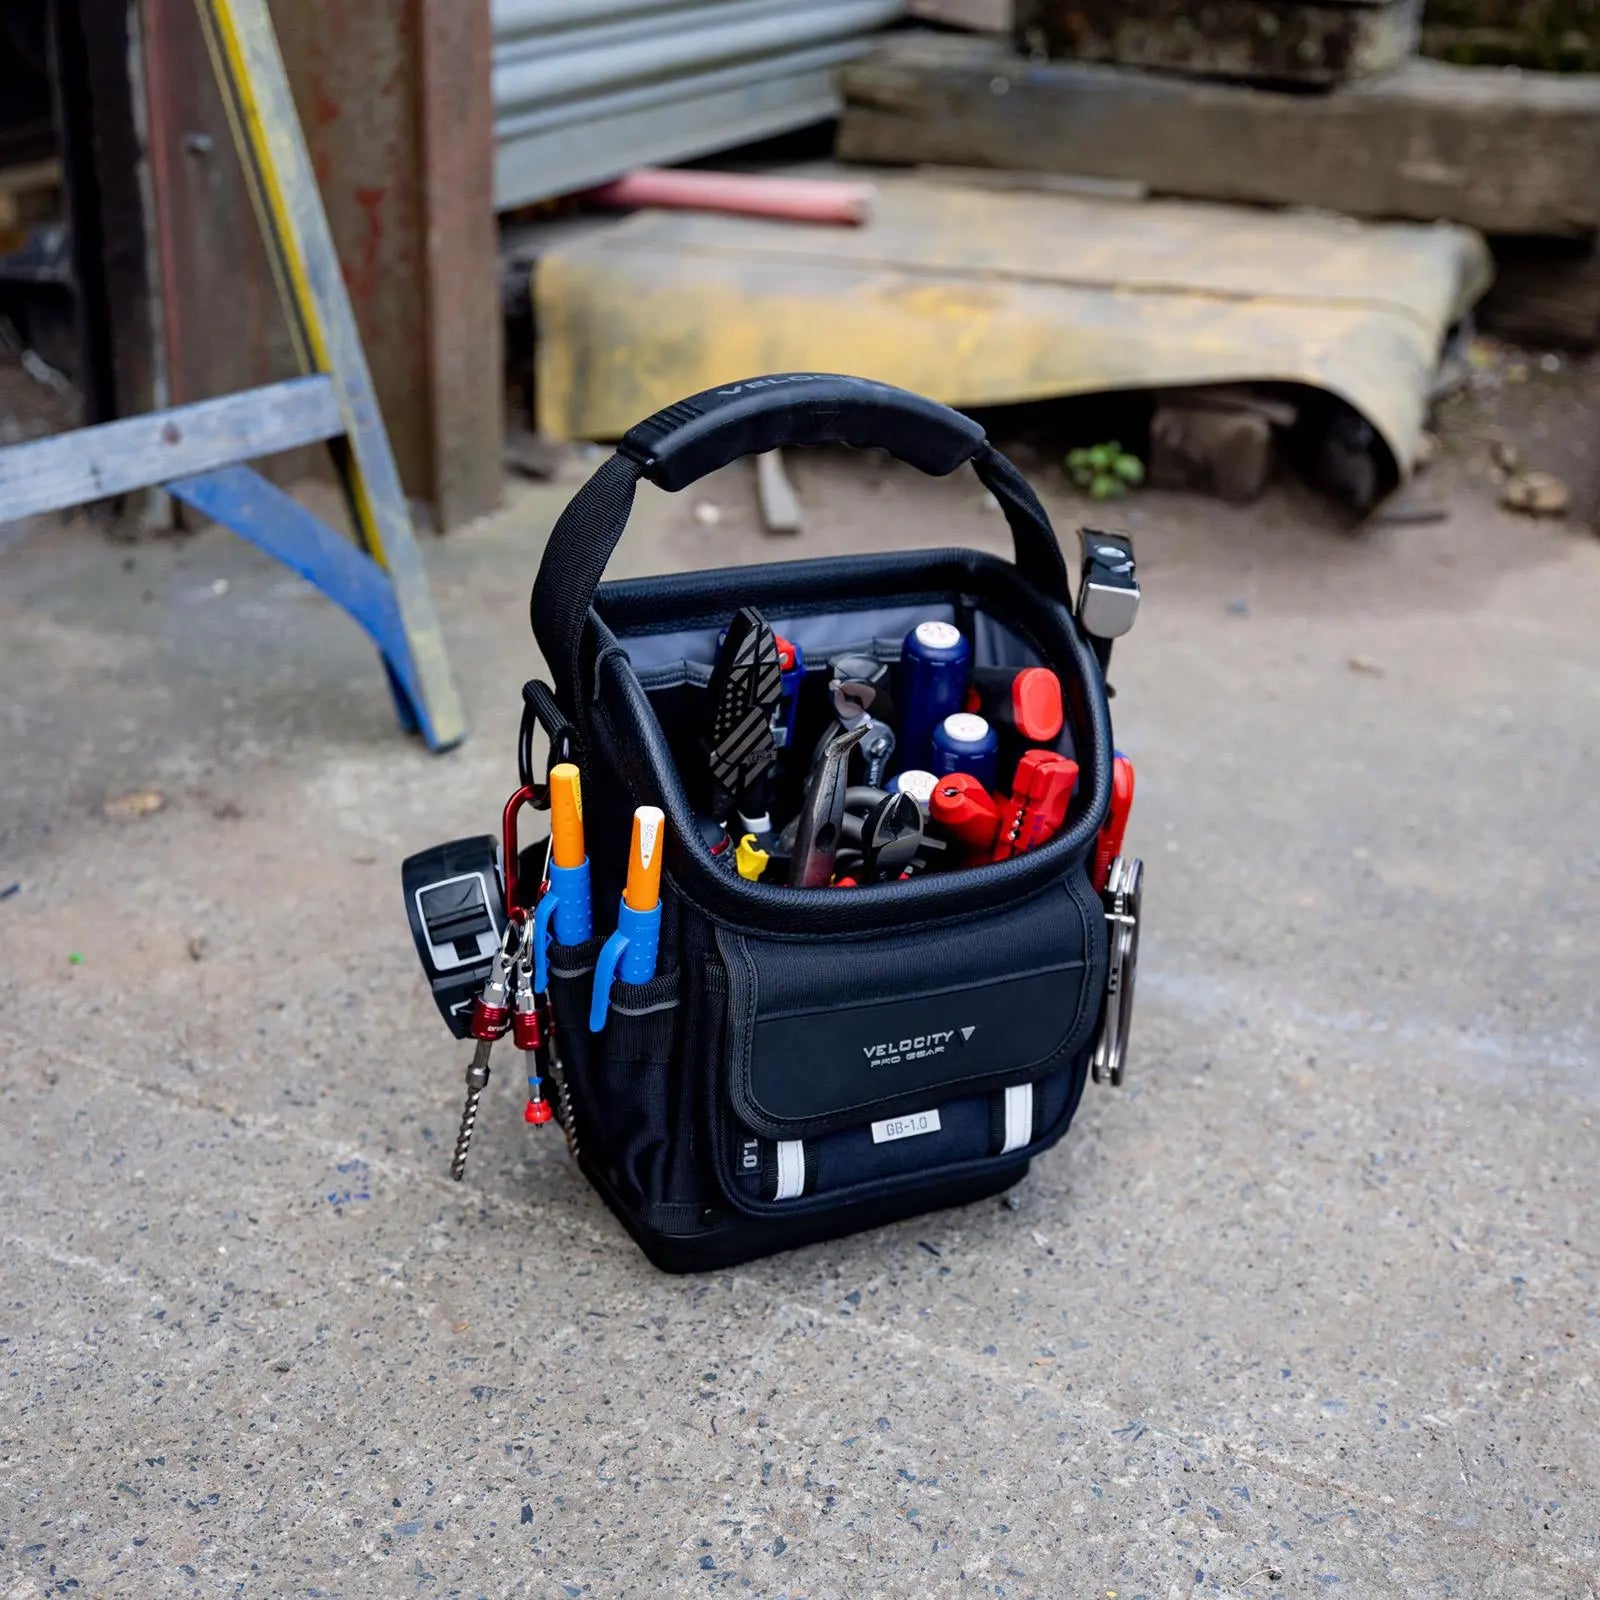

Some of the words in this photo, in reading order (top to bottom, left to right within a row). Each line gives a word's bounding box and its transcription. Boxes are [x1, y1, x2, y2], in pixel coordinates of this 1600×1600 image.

[863, 1030, 954, 1058] VELOCITY
[870, 1056, 901, 1068] PRO
[905, 1046, 945, 1060] GEAR
[886, 1116, 928, 1137] GB-1.0
[743, 1139, 758, 1168] 1.0
